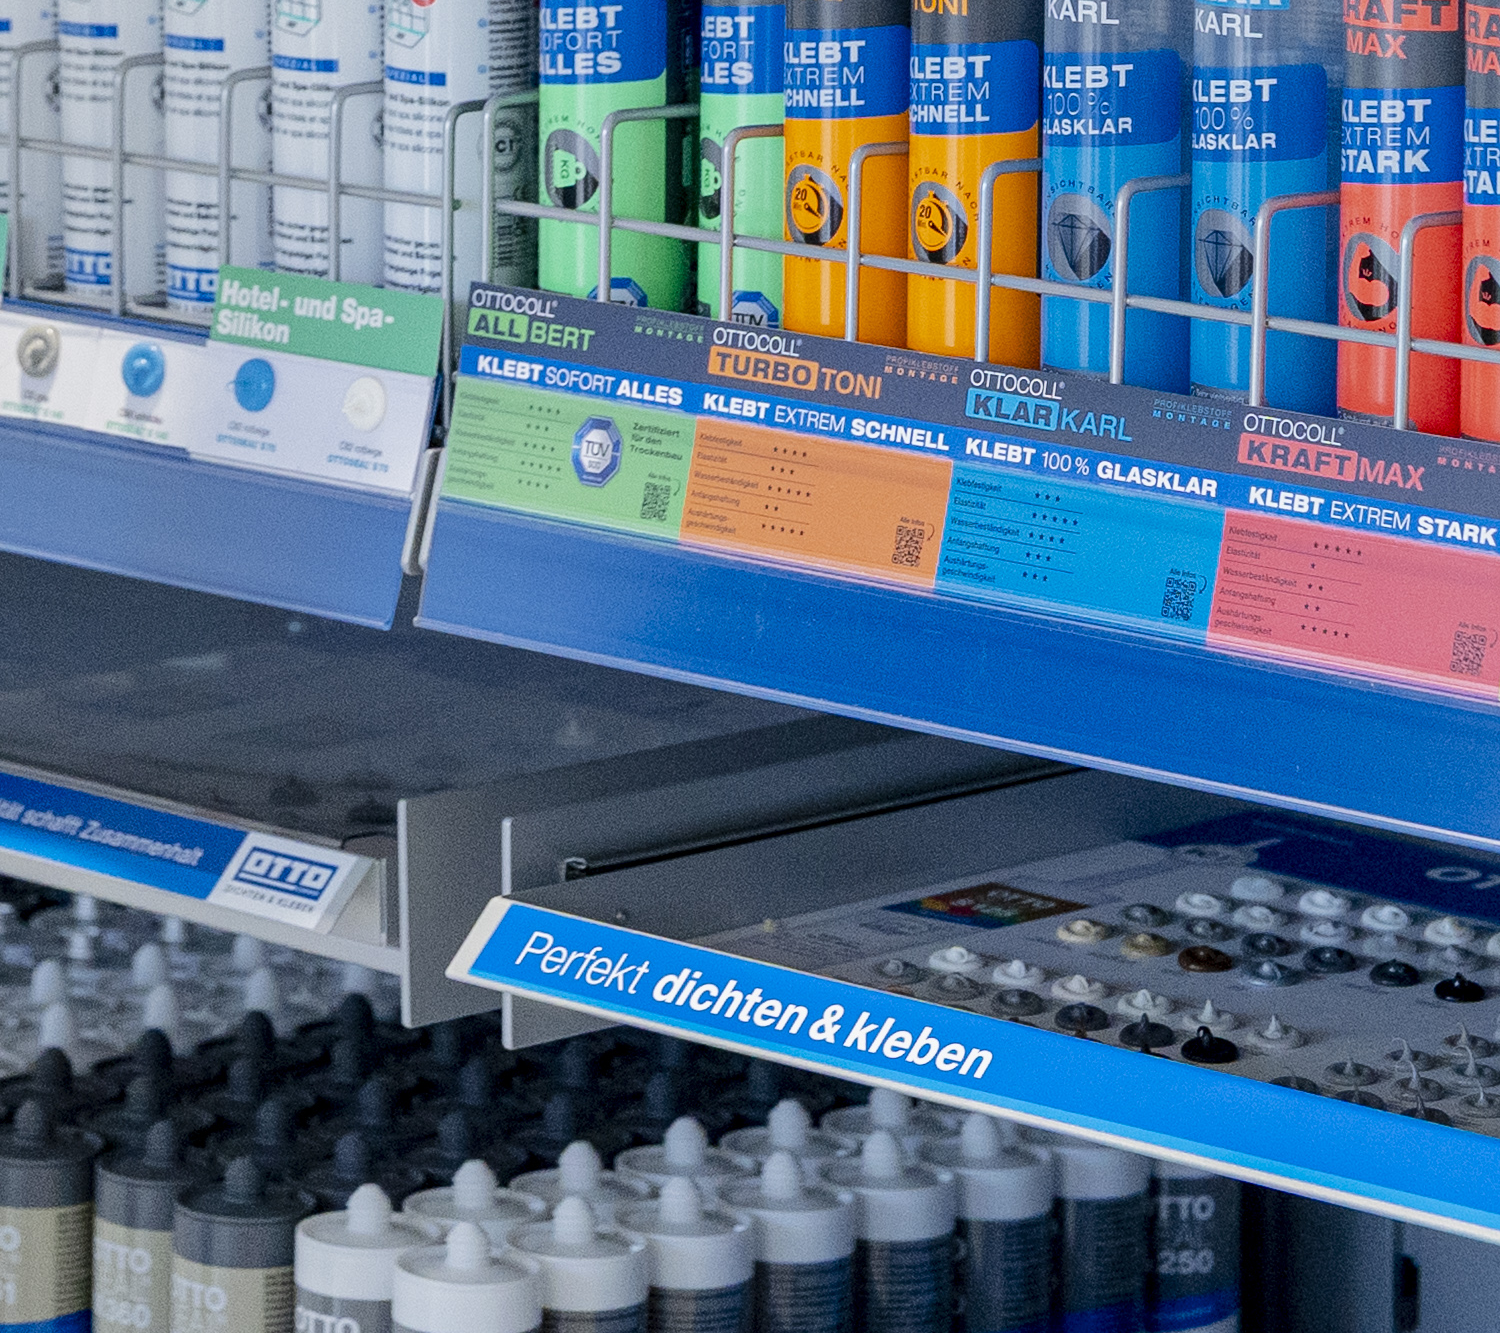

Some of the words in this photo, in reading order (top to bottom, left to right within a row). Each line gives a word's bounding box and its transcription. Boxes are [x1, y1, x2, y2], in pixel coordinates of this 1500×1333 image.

[1346, 29, 1407, 60] MAX
[217, 309, 290, 345] Silikon
[222, 279, 289, 313] Hotel-
[294, 291, 336, 320] und
[341, 298, 395, 331] Spa-
[475, 313, 521, 338] ALL
[531, 321, 595, 351] BERT
[477, 356, 544, 382] KLEBT
[545, 368, 615, 393] SOFORT
[617, 378, 684, 406] ALLES
[718, 351, 814, 387] TURBO
[822, 368, 882, 399] TONI
[704, 393, 770, 419] KLEBT
[774, 405, 846, 433] EXTREM
[850, 418, 950, 452] SCHNELL
[972, 392, 1056, 428] KLAR
[1060, 408, 1133, 441] KARL
[965, 438, 1036, 465] KLEBT
[1041, 452, 1071, 471] 100
[1074, 455, 1090, 475] %
[1097, 461, 1218, 498] GLASKLAR
[1247, 439, 1354, 478] KRAFT
[1357, 457, 1424, 491] MAX
[1249, 487, 1324, 515] KLEBT
[1330, 500, 1410, 531] EXTREM
[1417, 516, 1496, 546] STARK
[23, 808, 82, 835] schafft
[79, 819, 203, 866] Zusammenhalt
[242, 855, 331, 890] OTTO
[515, 930, 649, 995] Perfekt
[653, 968, 808, 1034] dichten
[809, 1004, 844, 1043] &
[844, 1012, 993, 1079] kleben
